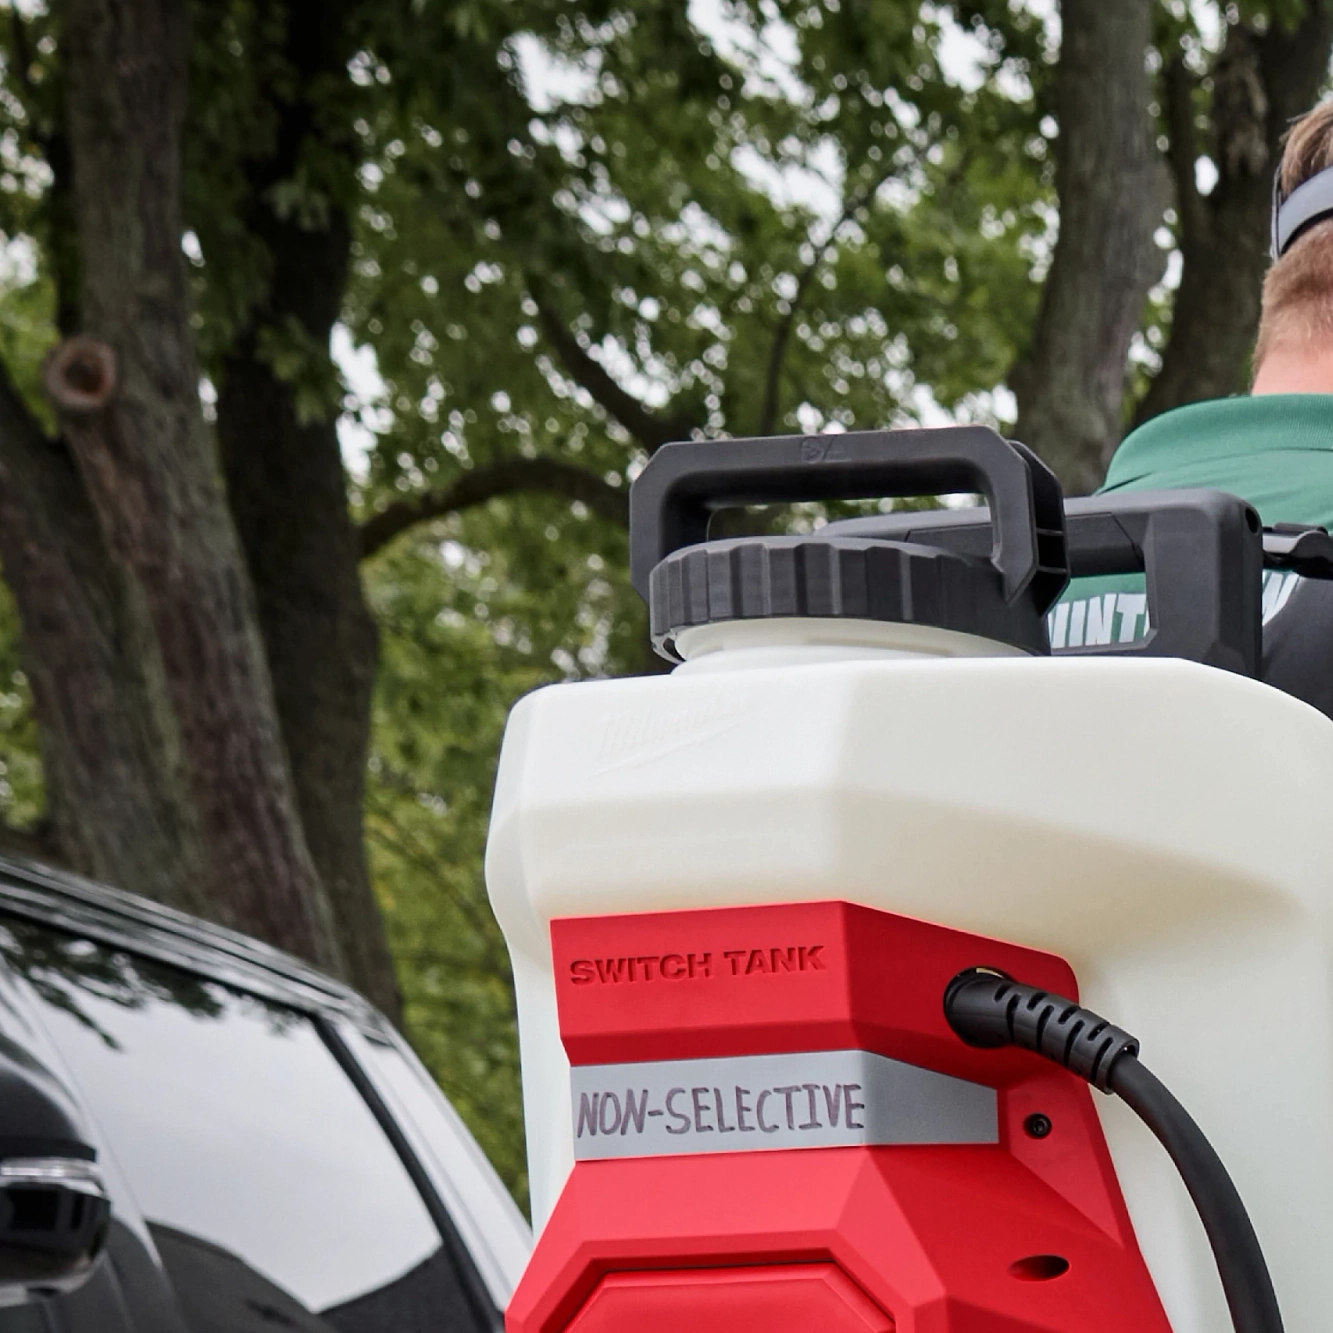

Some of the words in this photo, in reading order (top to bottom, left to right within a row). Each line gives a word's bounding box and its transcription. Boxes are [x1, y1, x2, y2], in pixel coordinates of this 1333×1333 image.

[569, 952, 710, 985] SWITCH
[724, 945, 826, 977] TANK
[576, 1083, 866, 1139] NON-SELECTIVE
